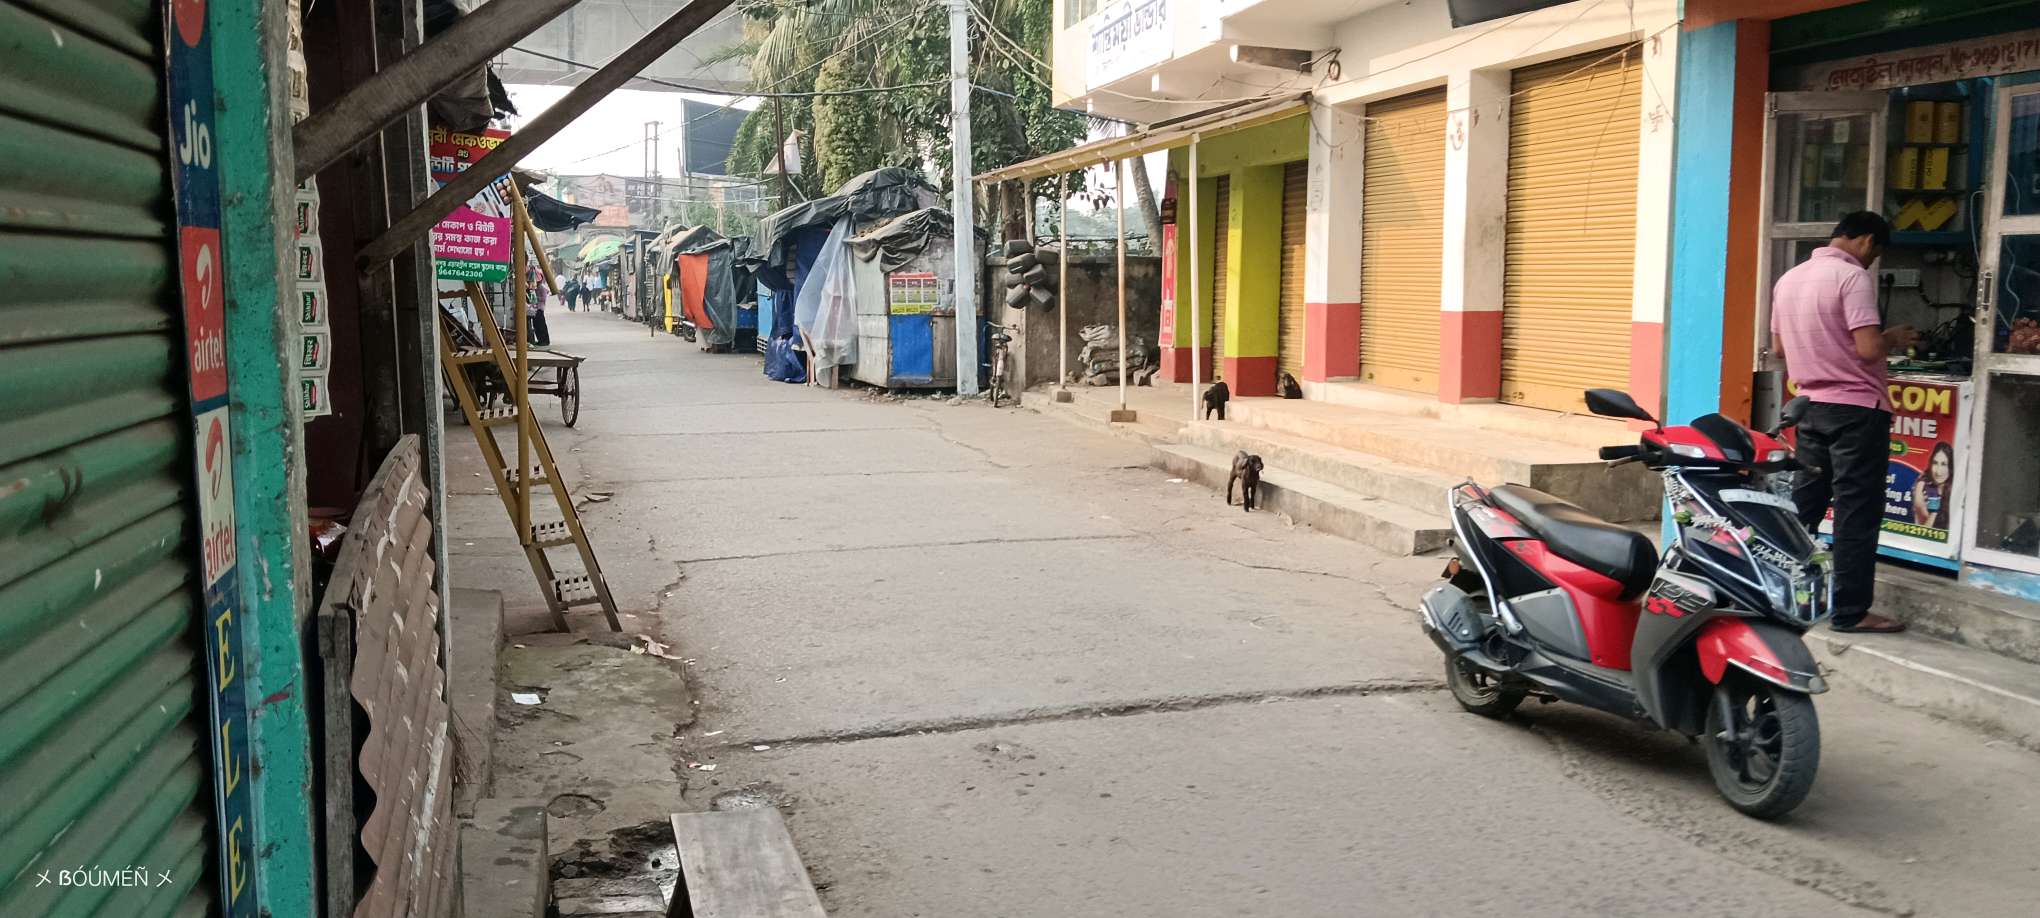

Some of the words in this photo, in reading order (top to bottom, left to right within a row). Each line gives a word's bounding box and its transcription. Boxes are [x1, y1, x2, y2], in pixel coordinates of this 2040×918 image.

[180, 99, 211, 169] Jio
[194, 326, 225, 374] airtel
[1888, 415, 1938, 439] INE
[1885, 502, 1908, 516] here
[204, 513, 235, 583] airtel
[215, 608, 250, 918] ELE
